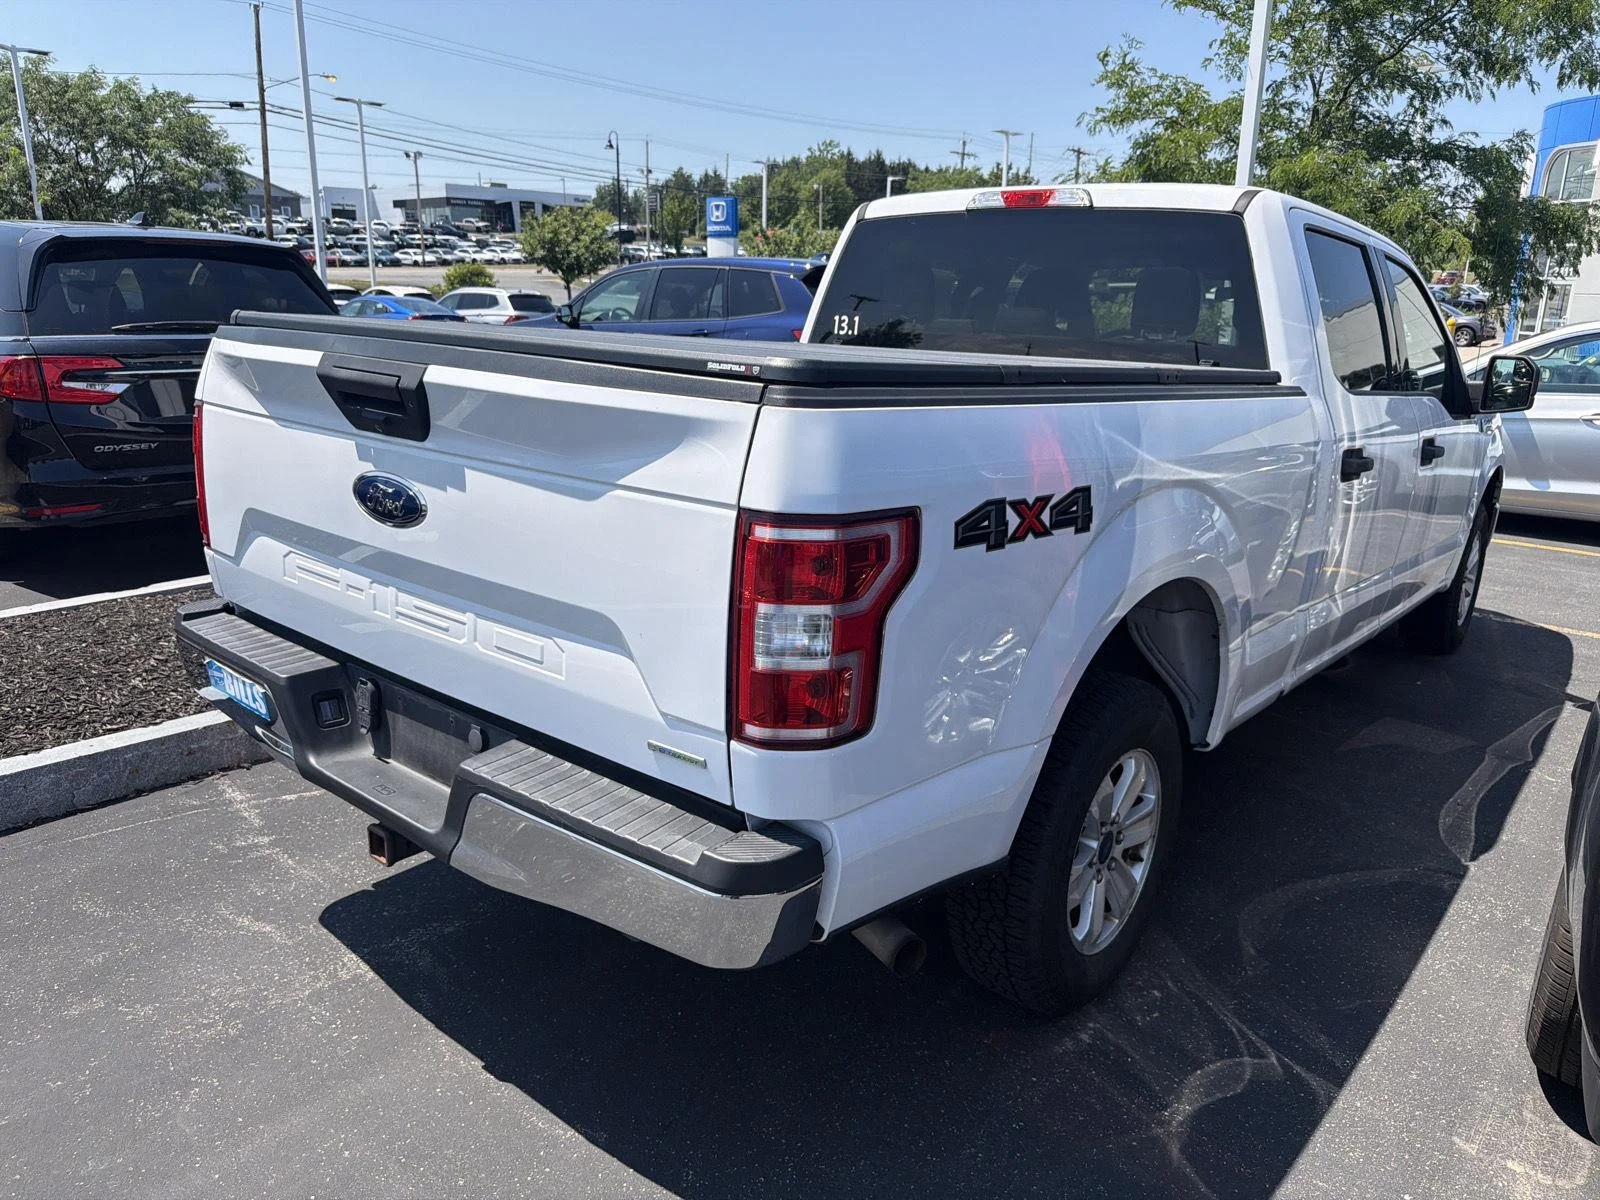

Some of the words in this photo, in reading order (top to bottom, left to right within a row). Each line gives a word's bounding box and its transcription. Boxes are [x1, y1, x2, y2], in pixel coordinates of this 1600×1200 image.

[833, 315, 860, 335] 13.1
[94, 442, 159, 453] ODYSSEY
[367, 482, 405, 517] Ford
[283, 550, 566, 681] F-150
[222, 670, 267, 715] BILLS
